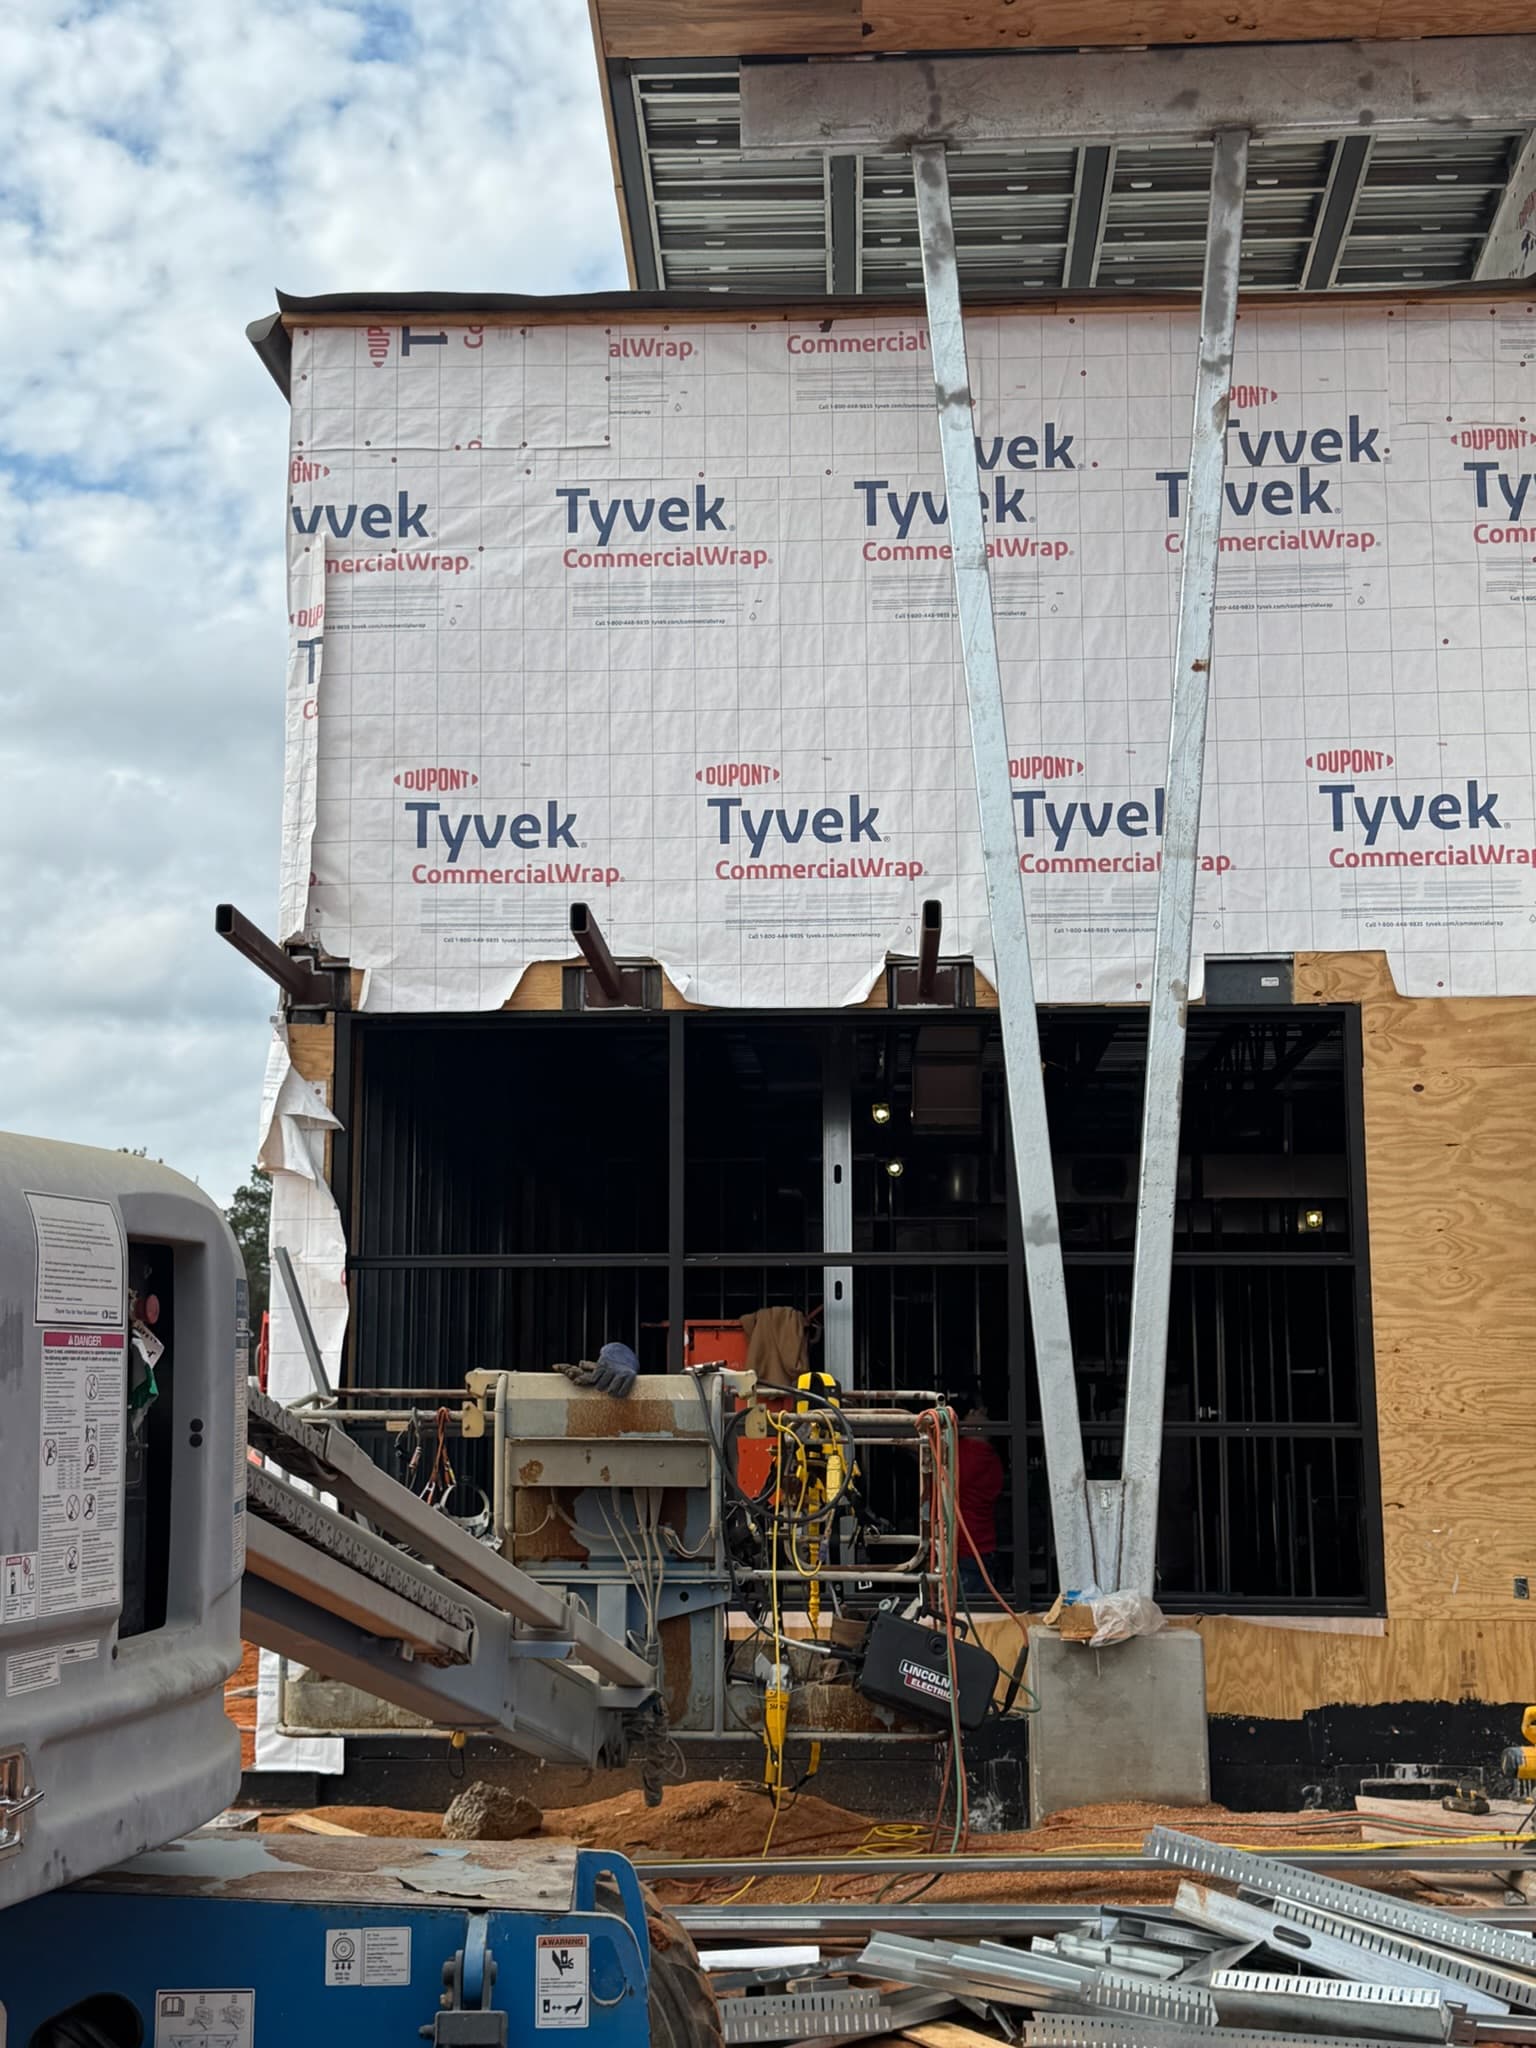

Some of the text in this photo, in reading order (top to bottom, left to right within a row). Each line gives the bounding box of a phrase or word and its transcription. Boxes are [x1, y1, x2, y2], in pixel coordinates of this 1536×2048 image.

[367, 326, 391, 358] DUP
[786, 331, 929, 355] Commercial
[1229, 385, 1269, 409] PONT
[975, 423, 1075, 470] vek
[1461, 428, 1528, 450] DUPONT
[291, 459, 321, 484] ONT
[1156, 468, 1332, 517] Tvek
[556, 485, 727, 546] Tyvek
[862, 538, 1069, 561] CommealWrap
[1165, 529, 1375, 552] CmercialWrap
[326, 552, 470, 575] mercialWrap
[562, 547, 768, 569] CommercialWrap
[298, 604, 324, 628] DUP
[1009, 756, 1074, 780] DUPONT
[1316, 749, 1384, 774] DUPONT
[404, 768, 469, 791] DUPONT
[706, 763, 771, 787] DUPONT
[1319, 780, 1501, 845] Tyvek
[405, 801, 579, 863] Tyvek
[707, 795, 881, 858] Tyvek
[715, 857, 924, 881] CommercialWrap
[1020, 851, 1231, 875] Commercialap
[412, 864, 620, 887] CommercialWrap
[74, 1335, 102, 1346] DANGER
[903, 1662, 951, 1688] LINCOLN
[548, 1938, 584, 1946] WARNING
